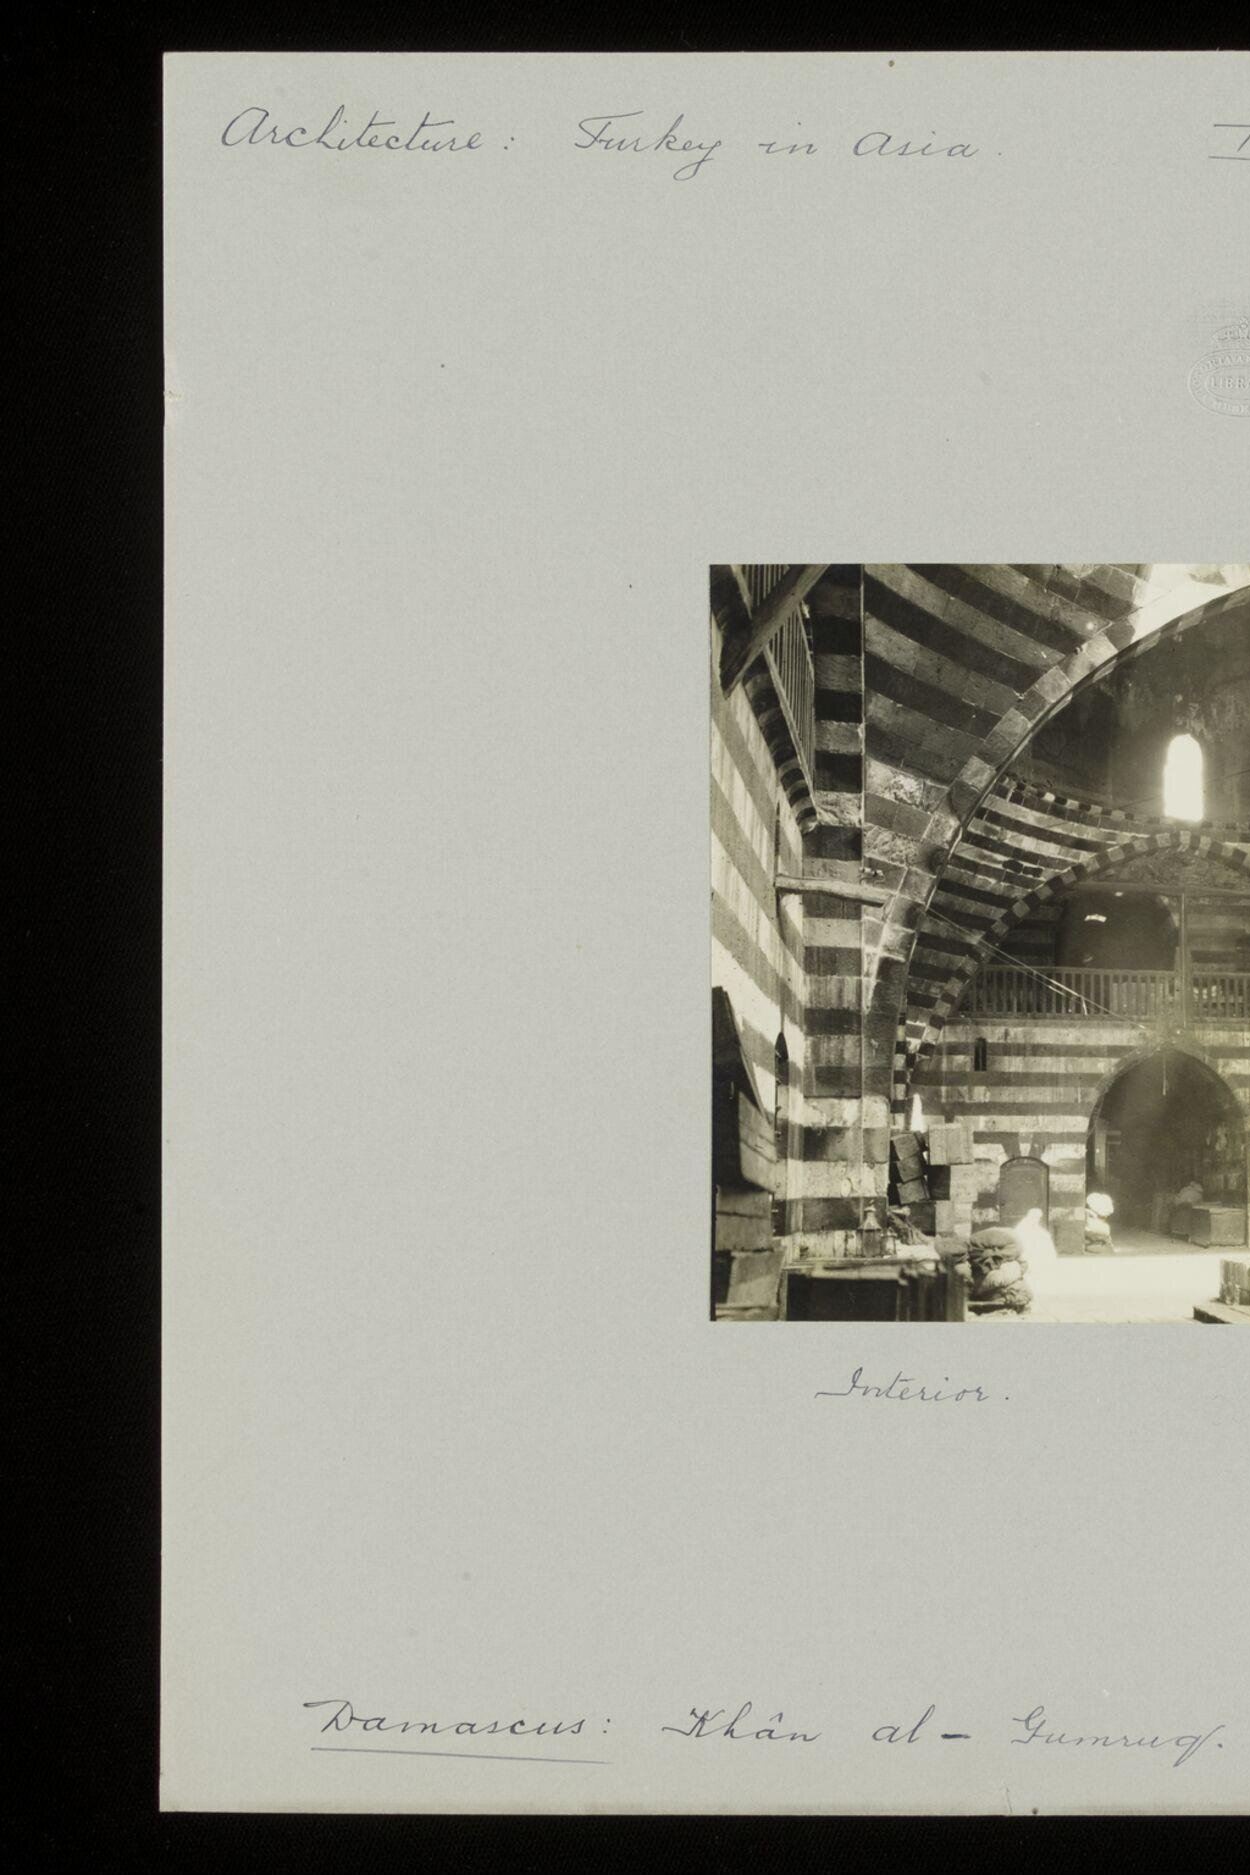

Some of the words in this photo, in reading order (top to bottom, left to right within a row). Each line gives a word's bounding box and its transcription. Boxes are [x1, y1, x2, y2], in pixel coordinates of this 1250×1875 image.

[221, 104, 515, 151] Architecture:
[574, 111, 722, 181] Turkey
[758, 122, 818, 155] in
[814, 1366, 1009, 1401] Interior.
[662, 1701, 822, 1742] Khân
